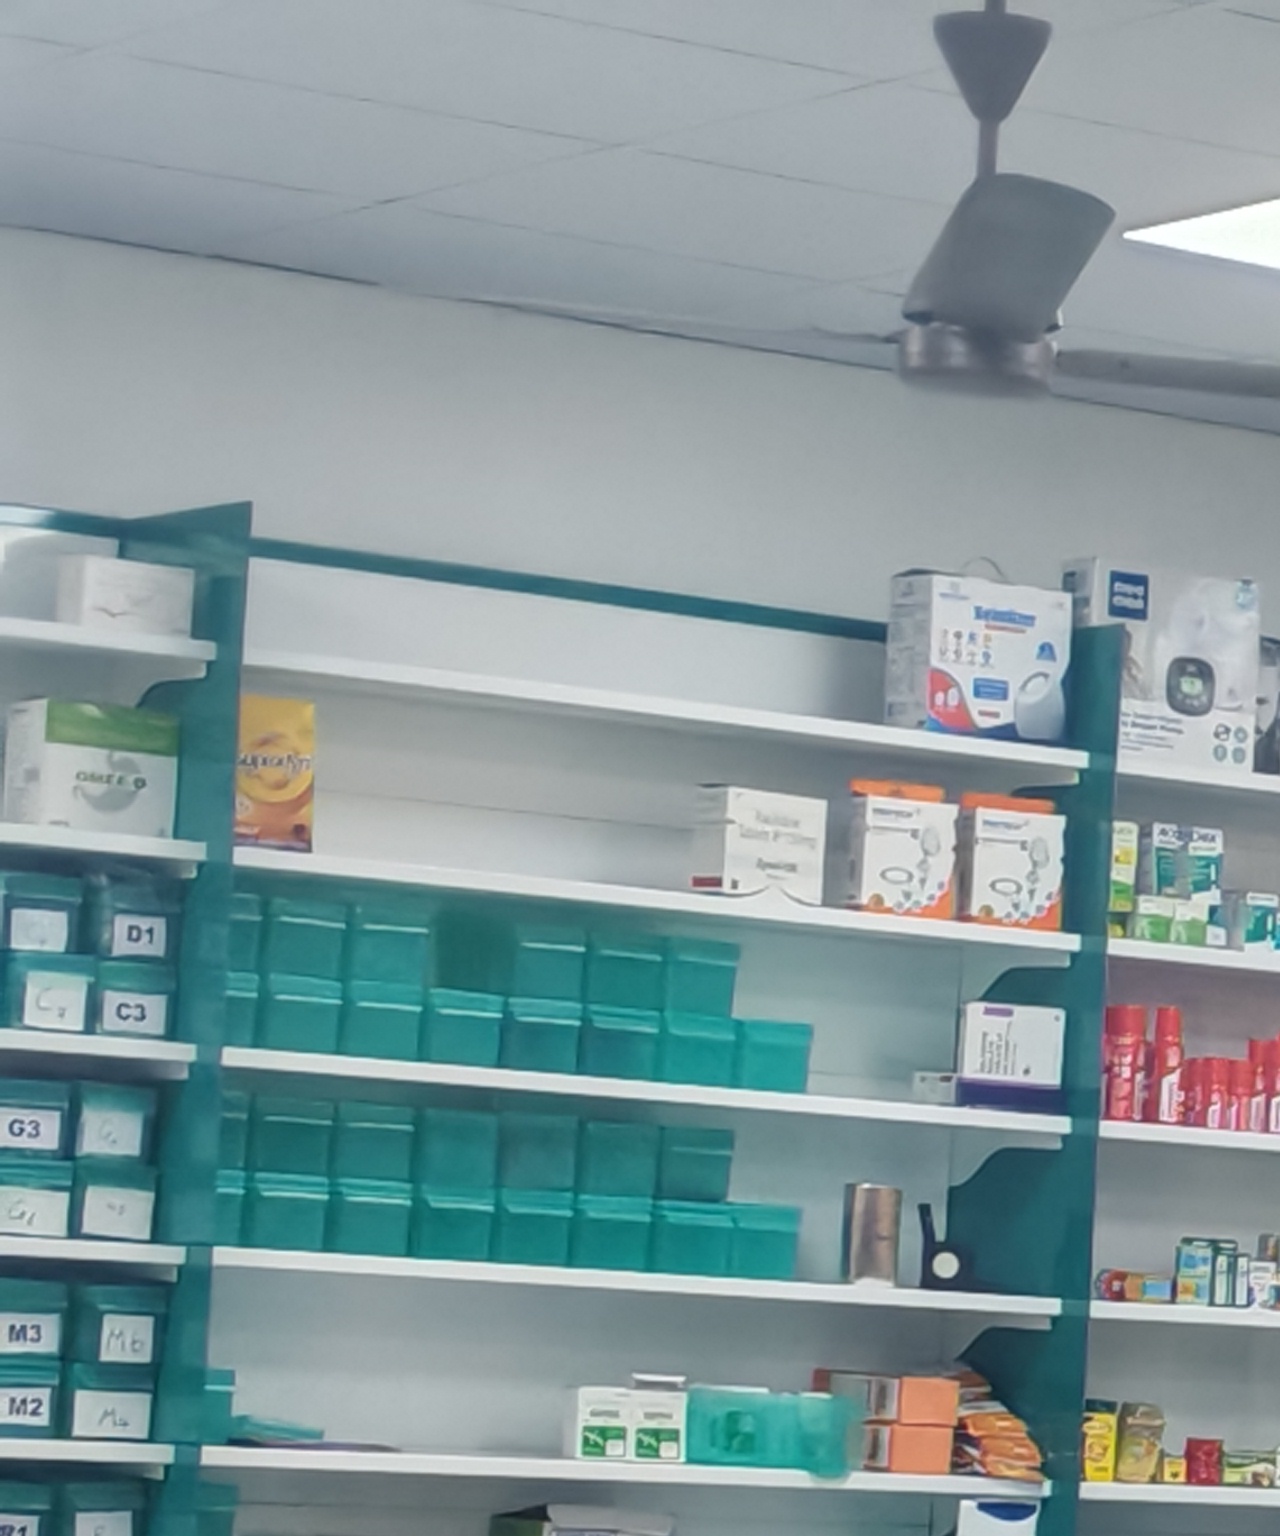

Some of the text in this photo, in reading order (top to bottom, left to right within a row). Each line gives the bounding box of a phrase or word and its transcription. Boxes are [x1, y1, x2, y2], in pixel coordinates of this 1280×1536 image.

[127, 925, 155, 943] D1
[116, 1002, 147, 1022] C3
[8, 1118, 41, 1139] G3
[8, 1324, 42, 1343] M3
[8, 1397, 43, 1417] M2
